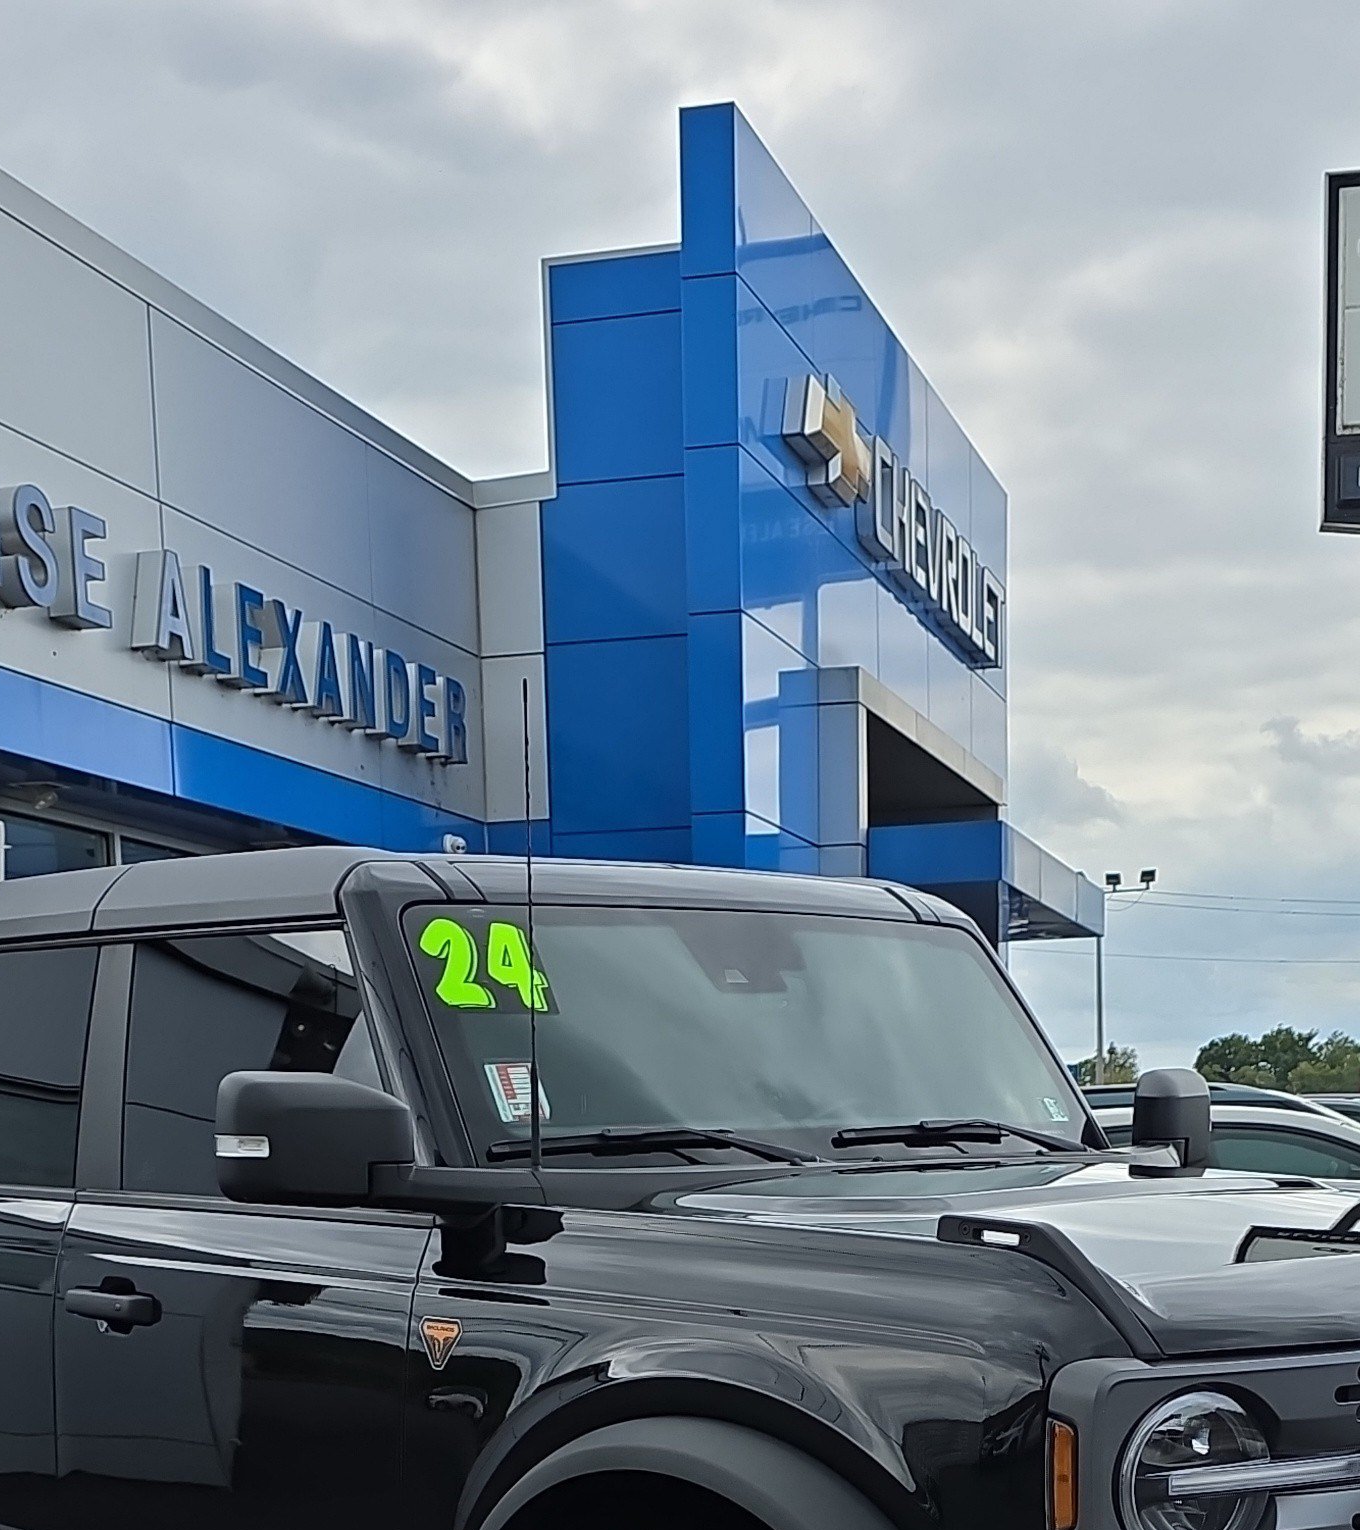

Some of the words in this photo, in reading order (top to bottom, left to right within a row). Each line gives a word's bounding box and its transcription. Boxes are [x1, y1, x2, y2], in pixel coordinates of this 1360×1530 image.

[158, 548, 468, 766] ALEXANDER
[870, 434, 1006, 669] CHEVROLET
[418, 916, 550, 1013] 24
